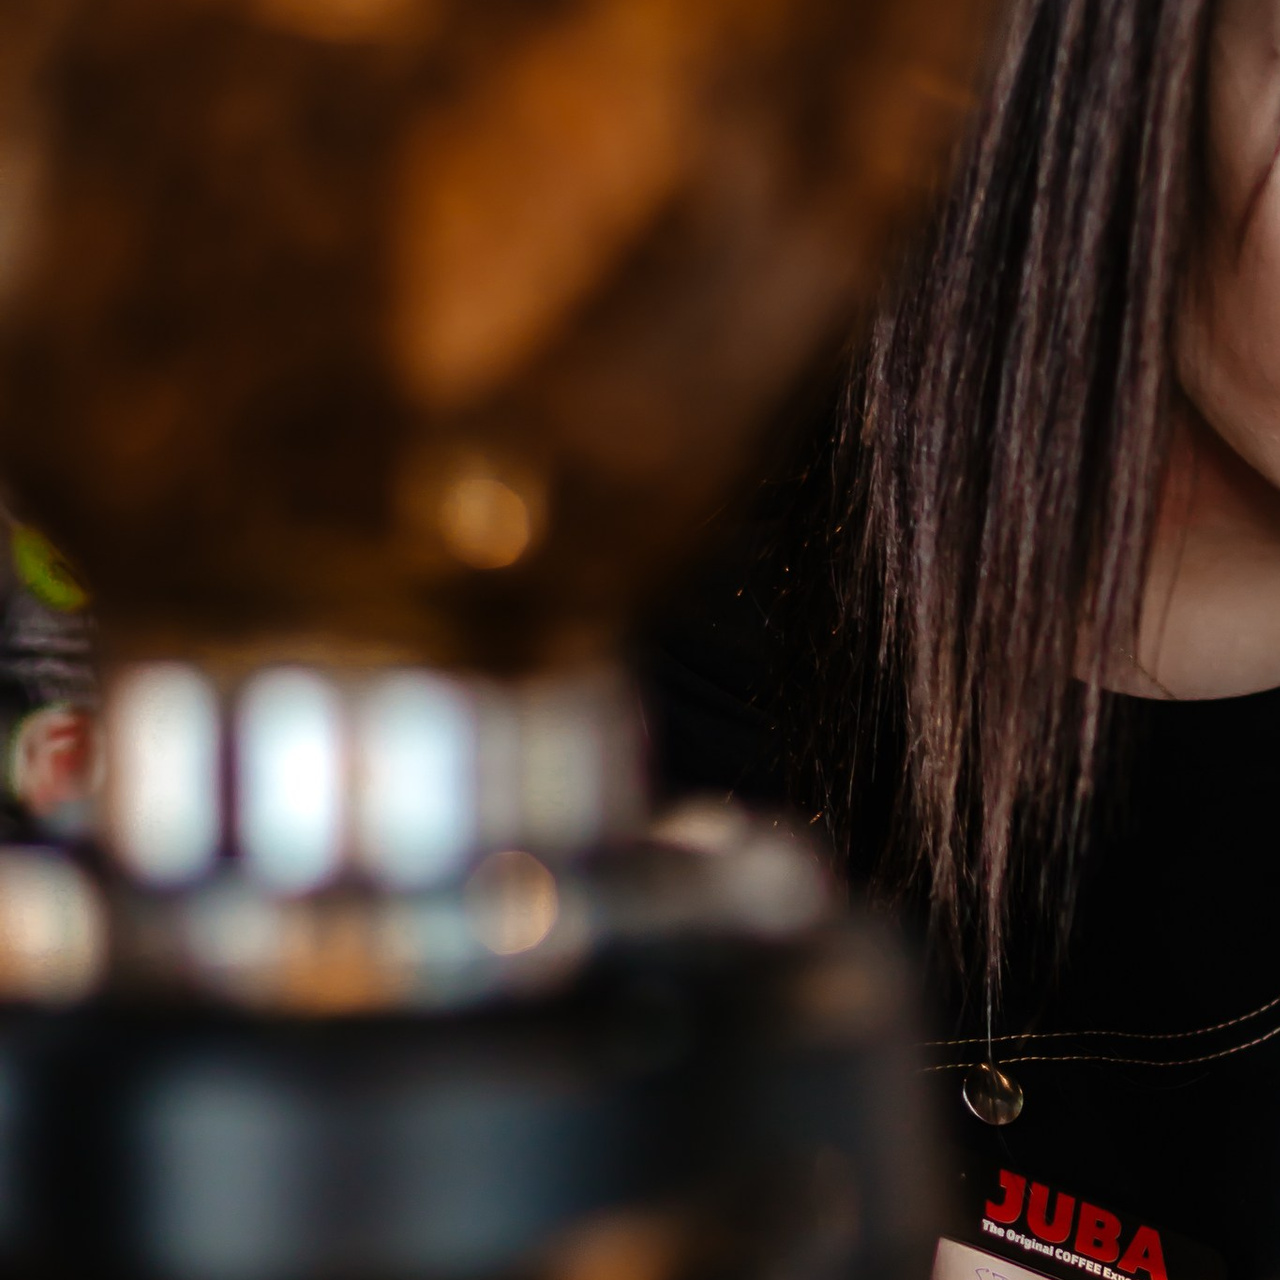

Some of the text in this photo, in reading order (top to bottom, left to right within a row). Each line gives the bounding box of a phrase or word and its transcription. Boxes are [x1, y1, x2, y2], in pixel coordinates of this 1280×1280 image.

[982, 1218, 1005, 1238] The
[1006, 1229, 1054, 1256] Original
[1055, 1248, 1102, 1276] COFFEE
